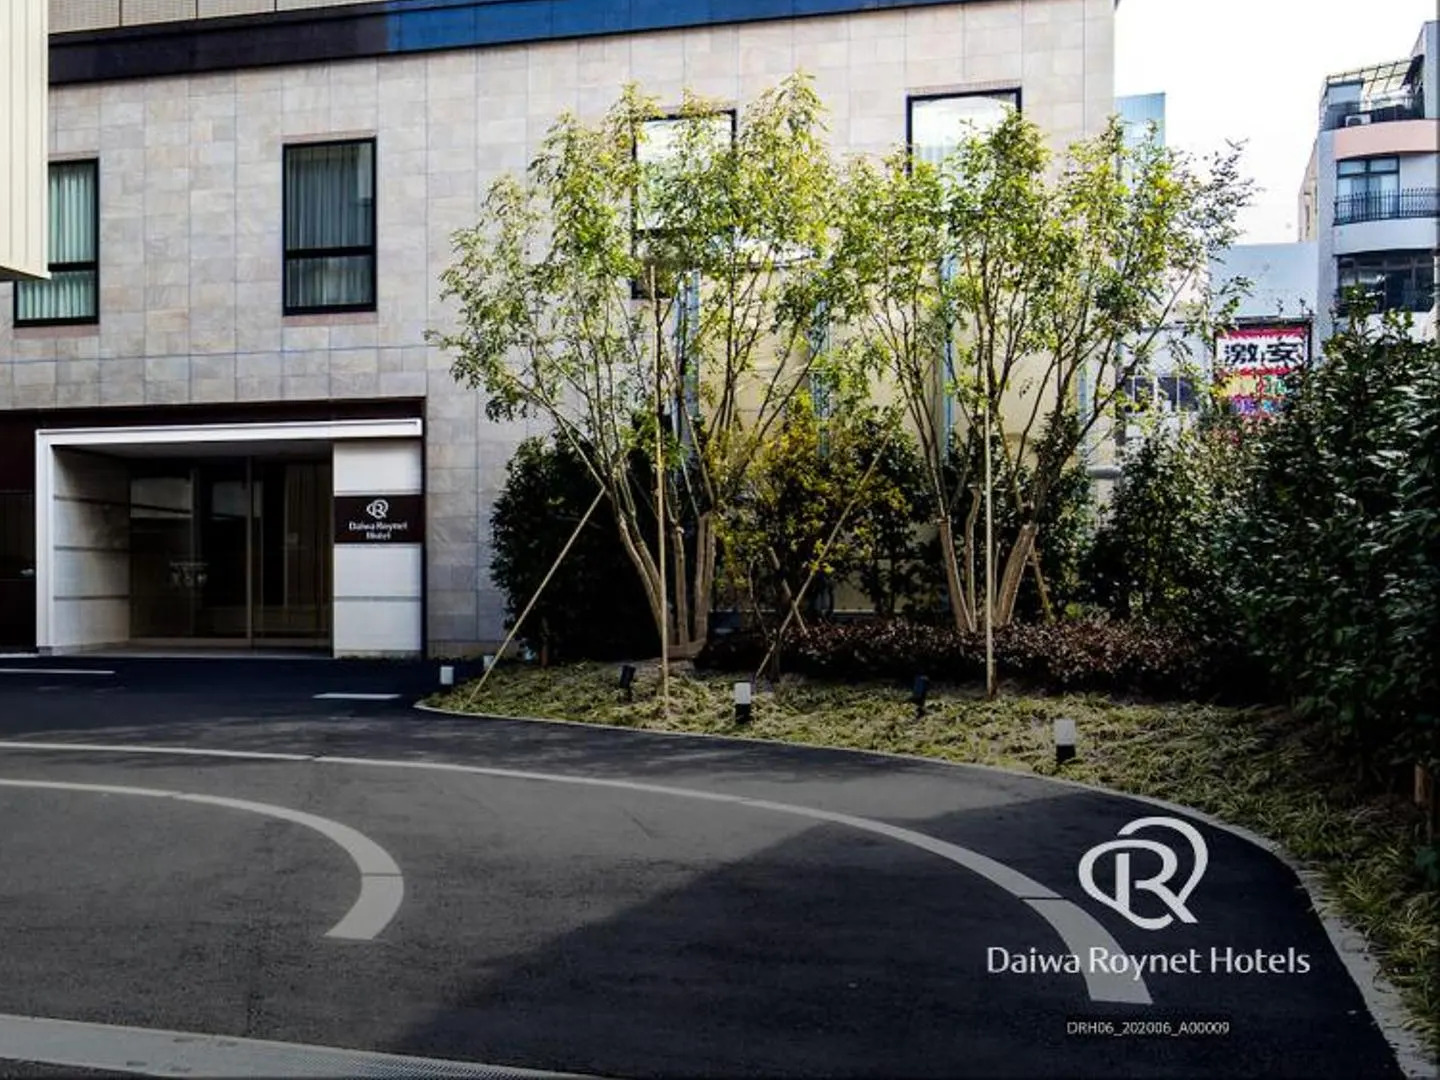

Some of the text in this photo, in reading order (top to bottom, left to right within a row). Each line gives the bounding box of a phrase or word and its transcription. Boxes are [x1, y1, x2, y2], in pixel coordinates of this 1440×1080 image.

[1224, 336, 1302, 365] 激安
[348, 521, 408, 532] Daiwa Roynet
[366, 531, 391, 540] Hotel
